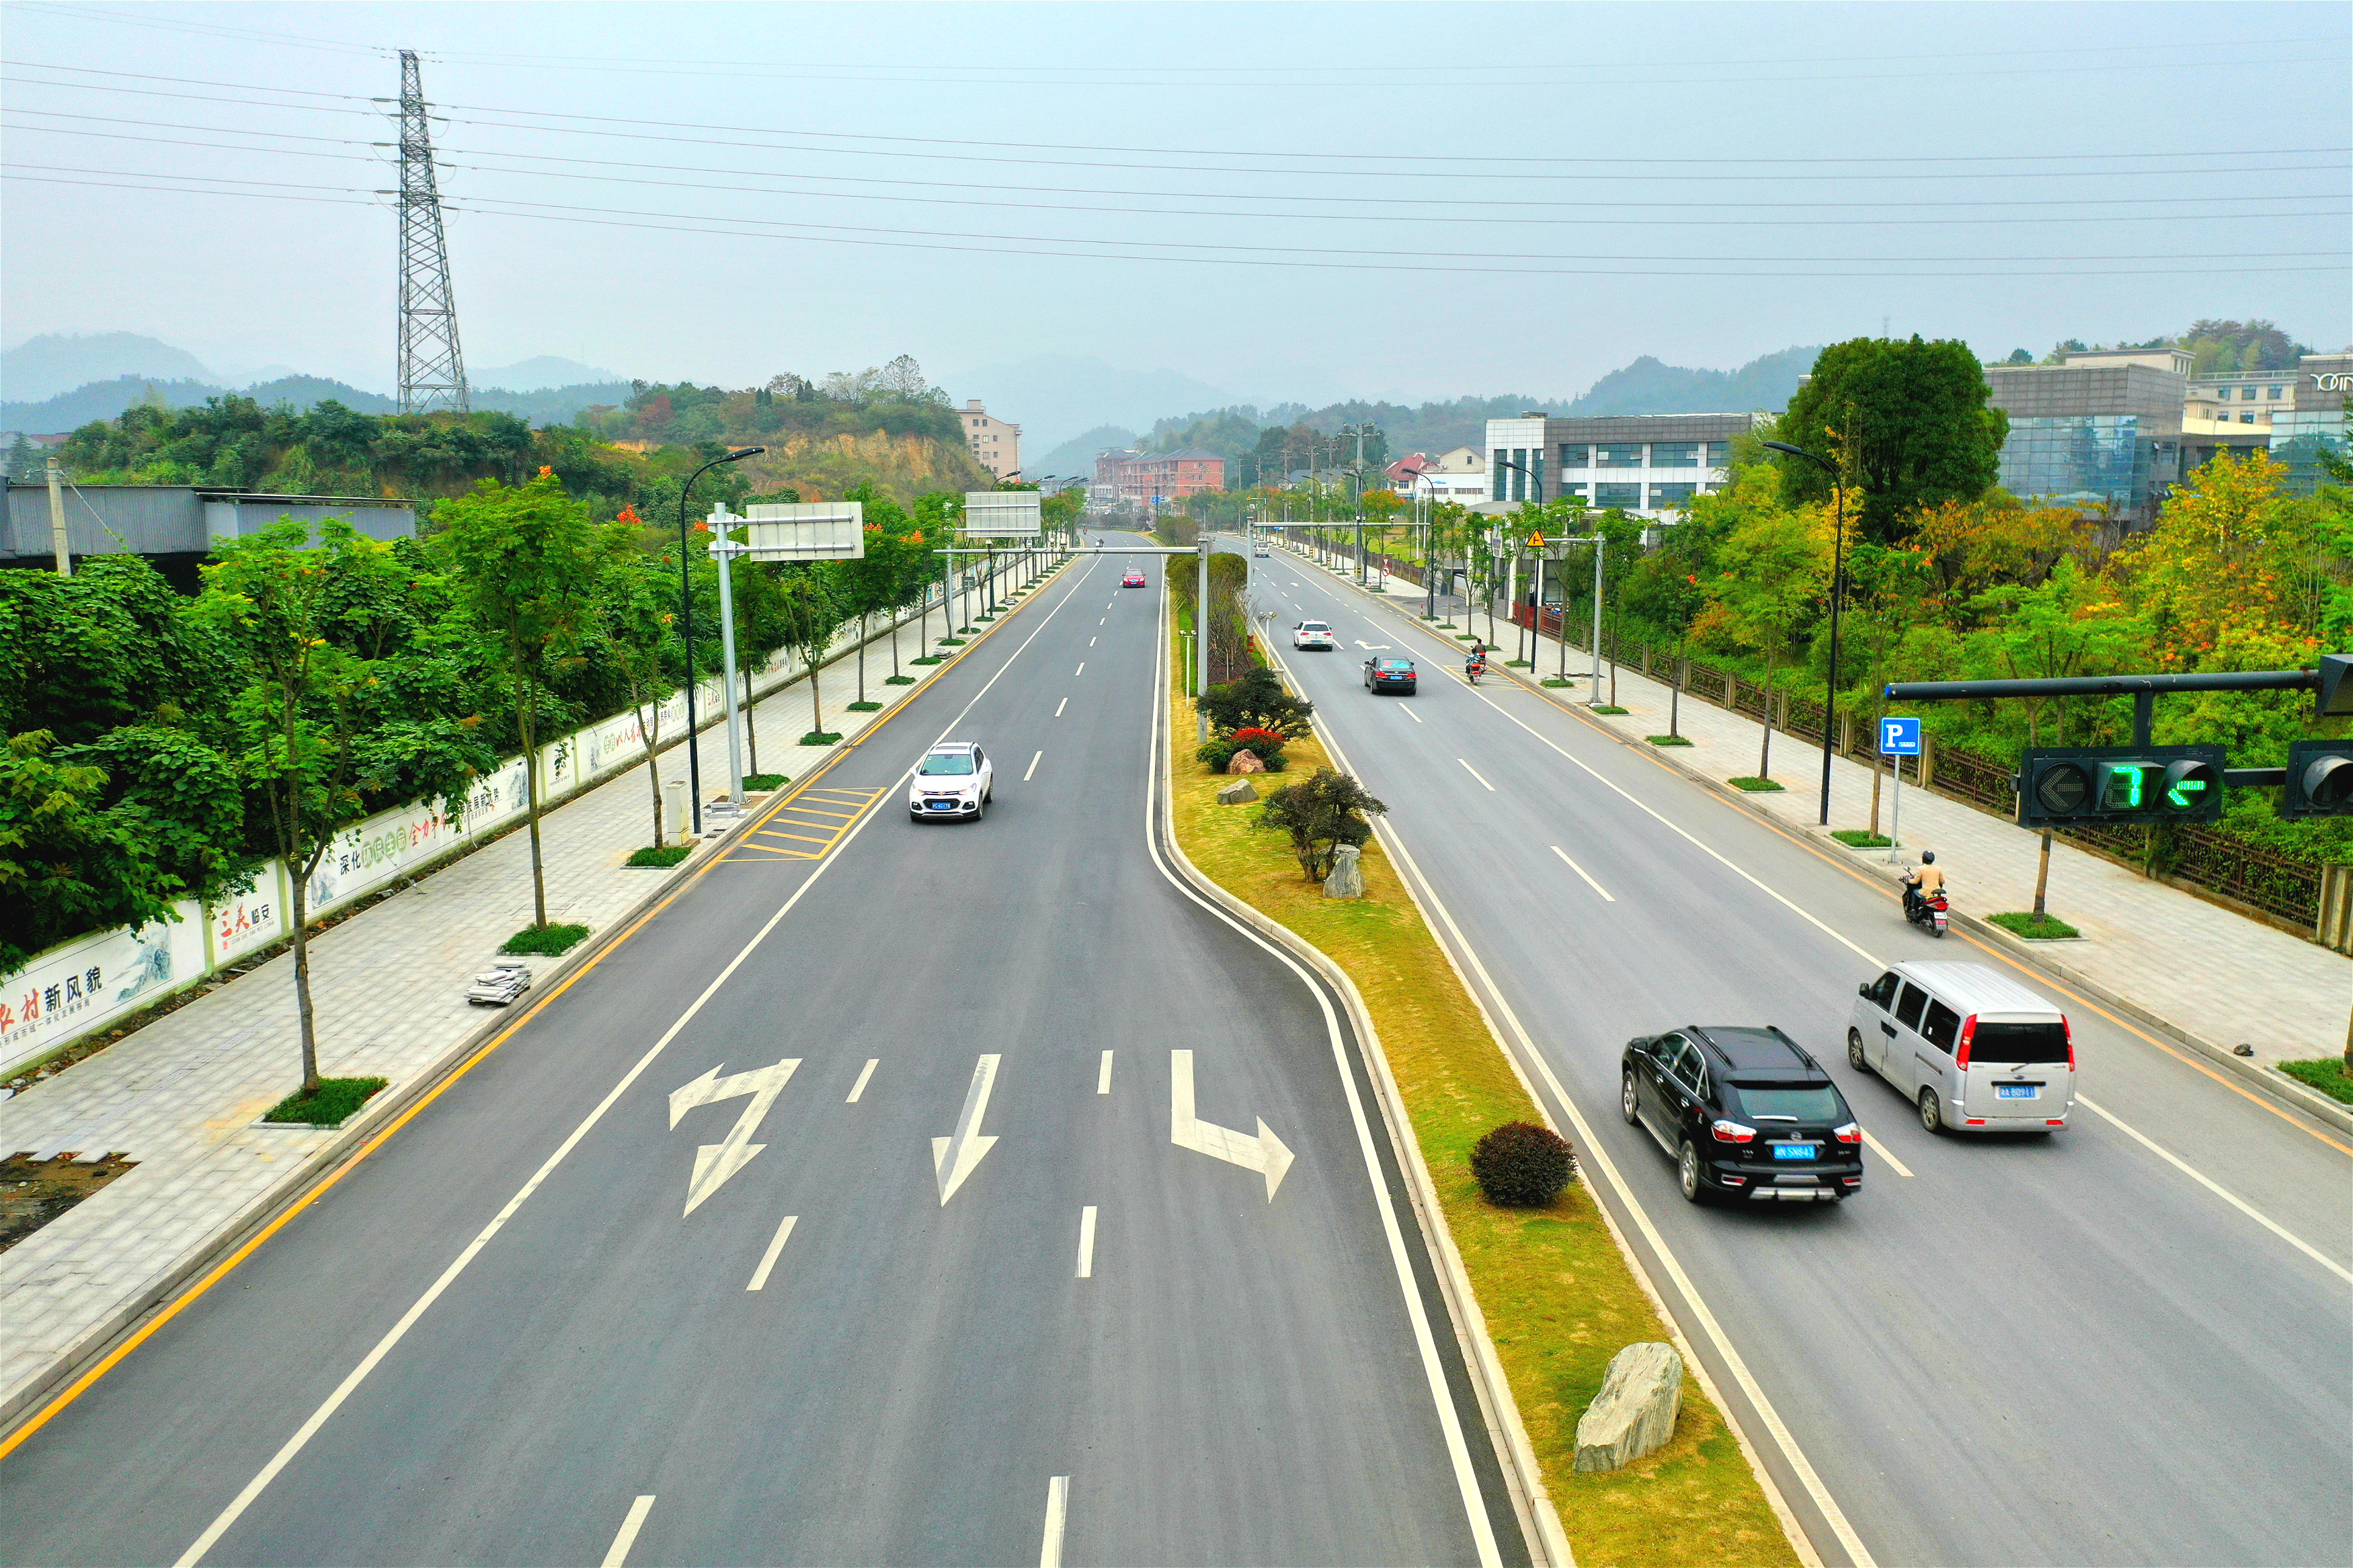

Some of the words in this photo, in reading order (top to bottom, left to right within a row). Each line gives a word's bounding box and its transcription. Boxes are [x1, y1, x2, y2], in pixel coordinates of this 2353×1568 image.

[1885, 724, 1903, 747] P
[2114, 766, 2141, 807] 7
[221, 901, 270, 938] 三美临安
